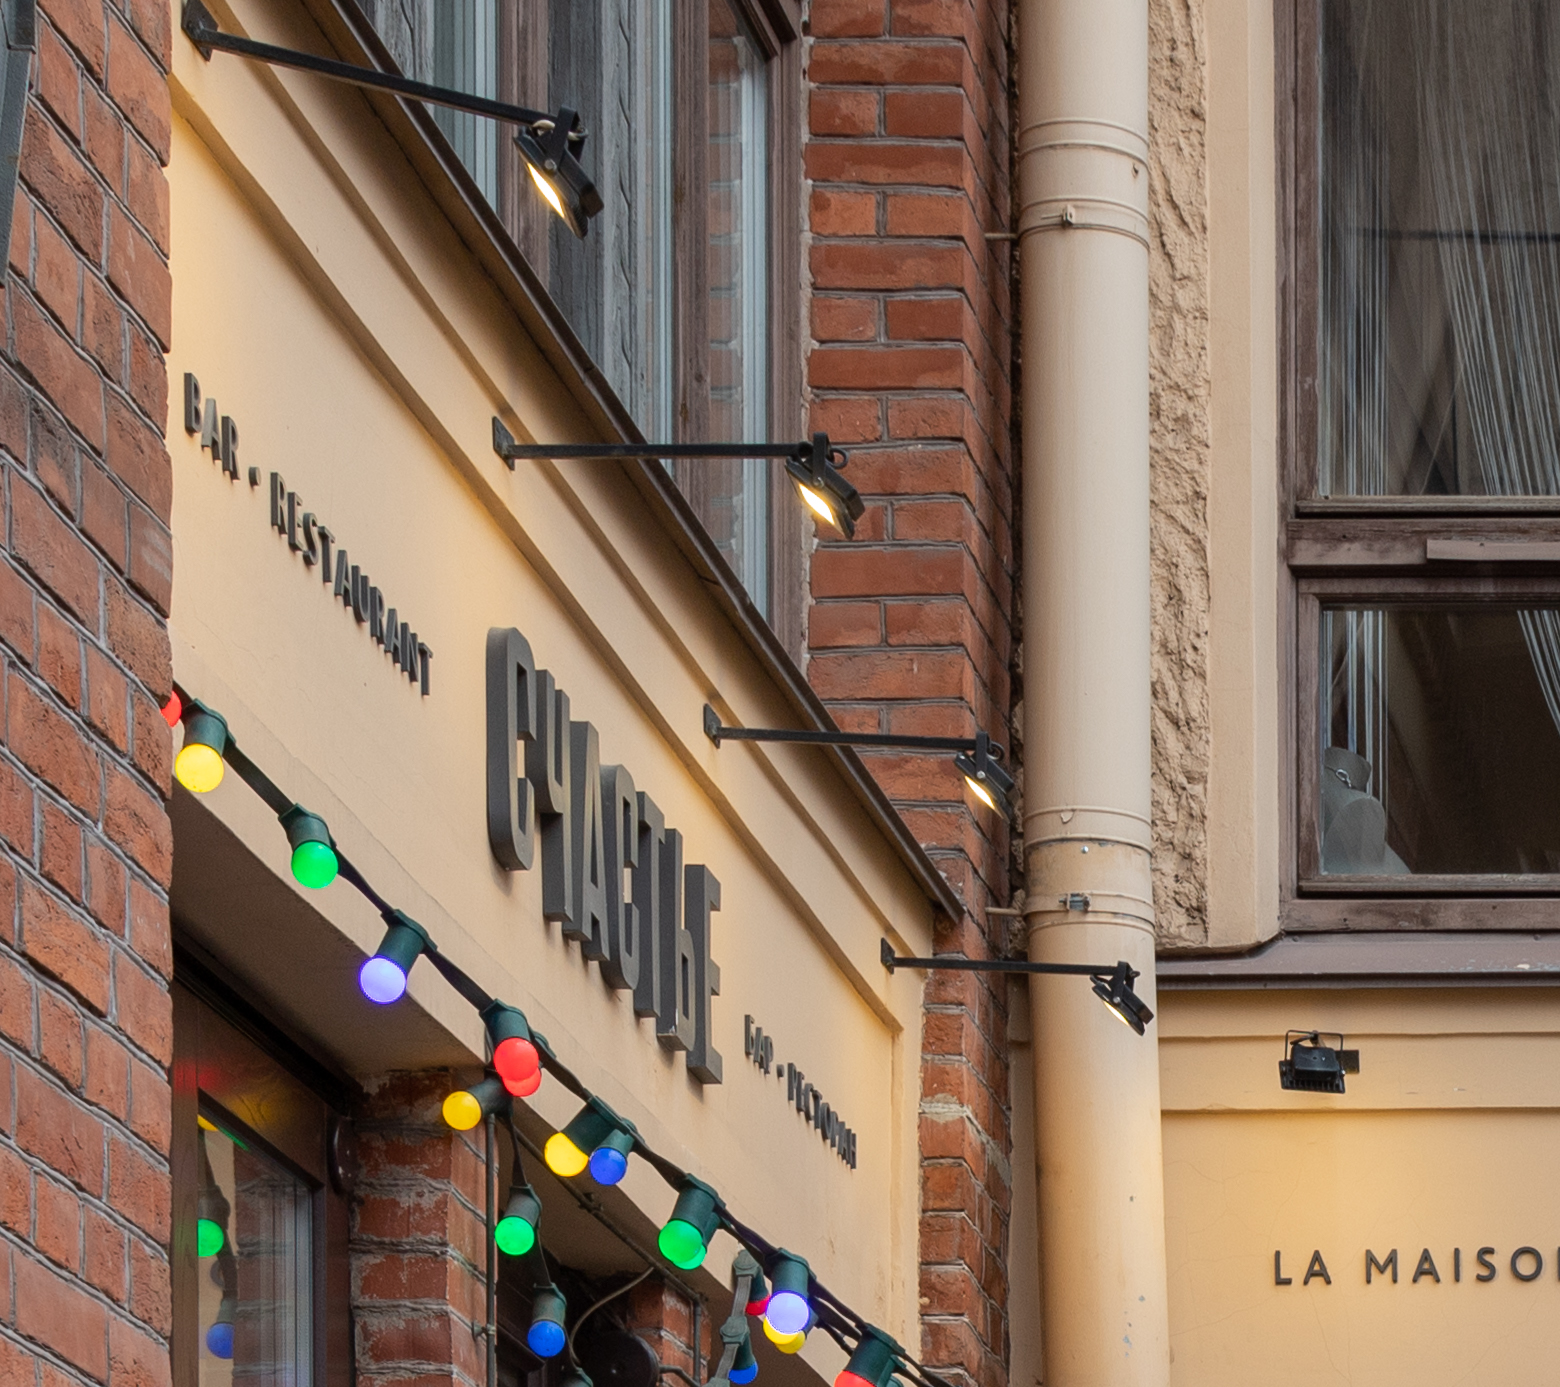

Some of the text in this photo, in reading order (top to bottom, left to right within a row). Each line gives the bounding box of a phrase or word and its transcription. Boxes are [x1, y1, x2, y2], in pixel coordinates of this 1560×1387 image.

[184, 372, 240, 480] BAR
[270, 472, 433, 696] RESTAURANT
[486, 627, 723, 1084] СЧАСТЬЕ
[744, 1014, 774, 1075] БАР
[788, 1062, 857, 1170] РЕСТОРАН
[1274, 1250, 1332, 1286] LA
